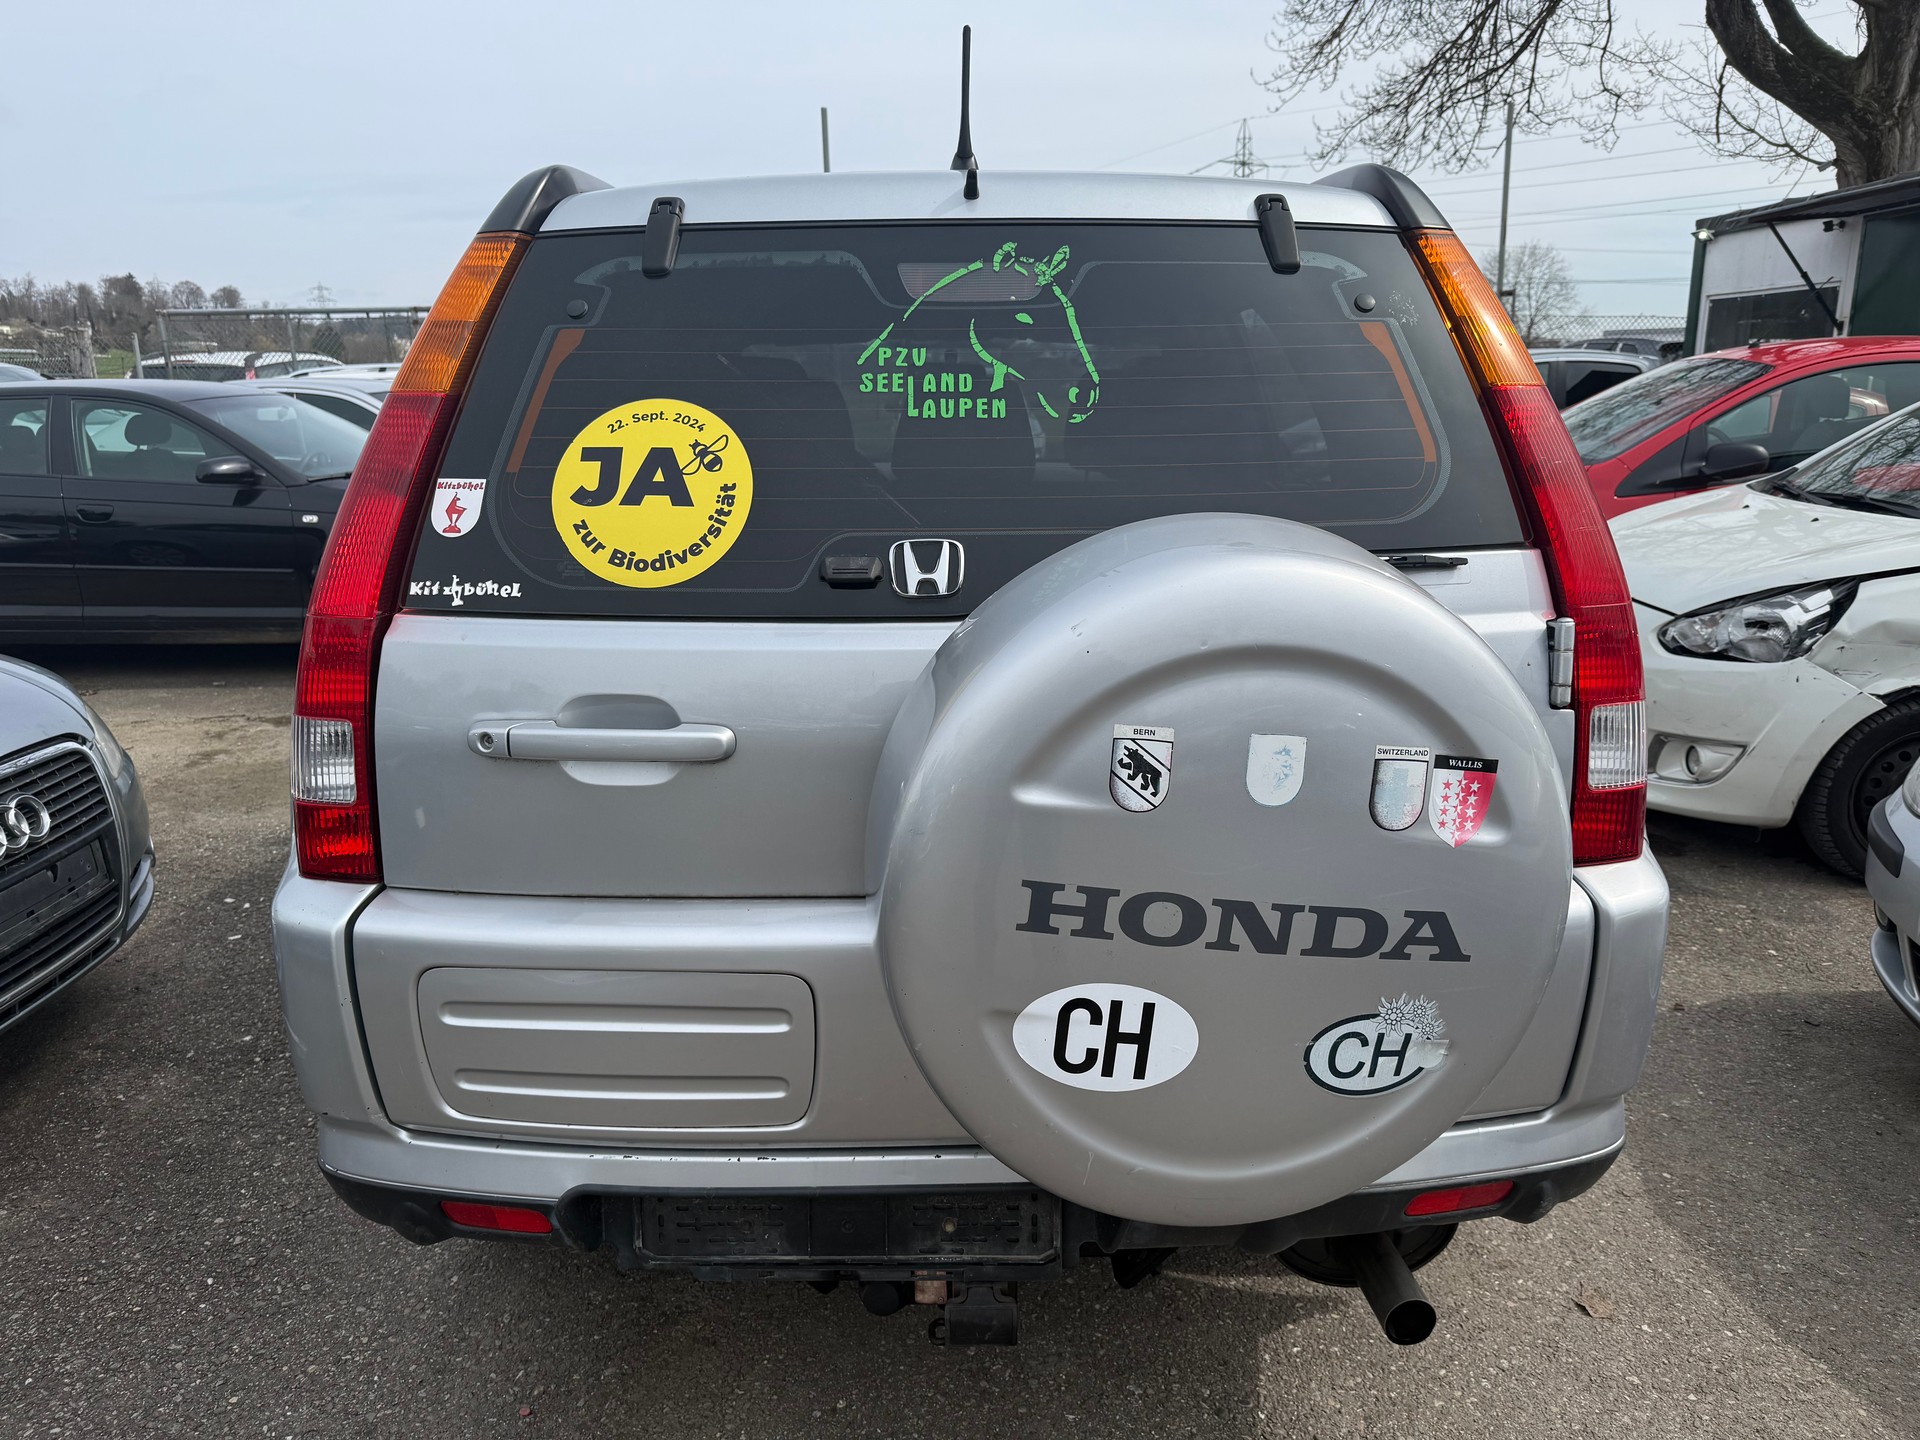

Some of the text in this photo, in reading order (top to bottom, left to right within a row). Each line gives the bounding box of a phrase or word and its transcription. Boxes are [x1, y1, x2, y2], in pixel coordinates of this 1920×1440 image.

[907, 375, 1006, 418] LAUPEN
[607, 410, 706, 434] 22. Sept. 2024
[569, 446, 695, 507] JA
[572, 482, 737, 573] zur Biodiversität
[1132, 728, 1156, 737] BERN
[1377, 748, 1429, 757] SWITZERLAND
[1449, 759, 1483, 769] WALLIS
[1015, 879, 1472, 962] HONDA
[1053, 997, 1156, 1080] CH
[1327, 1031, 1413, 1079] CH
